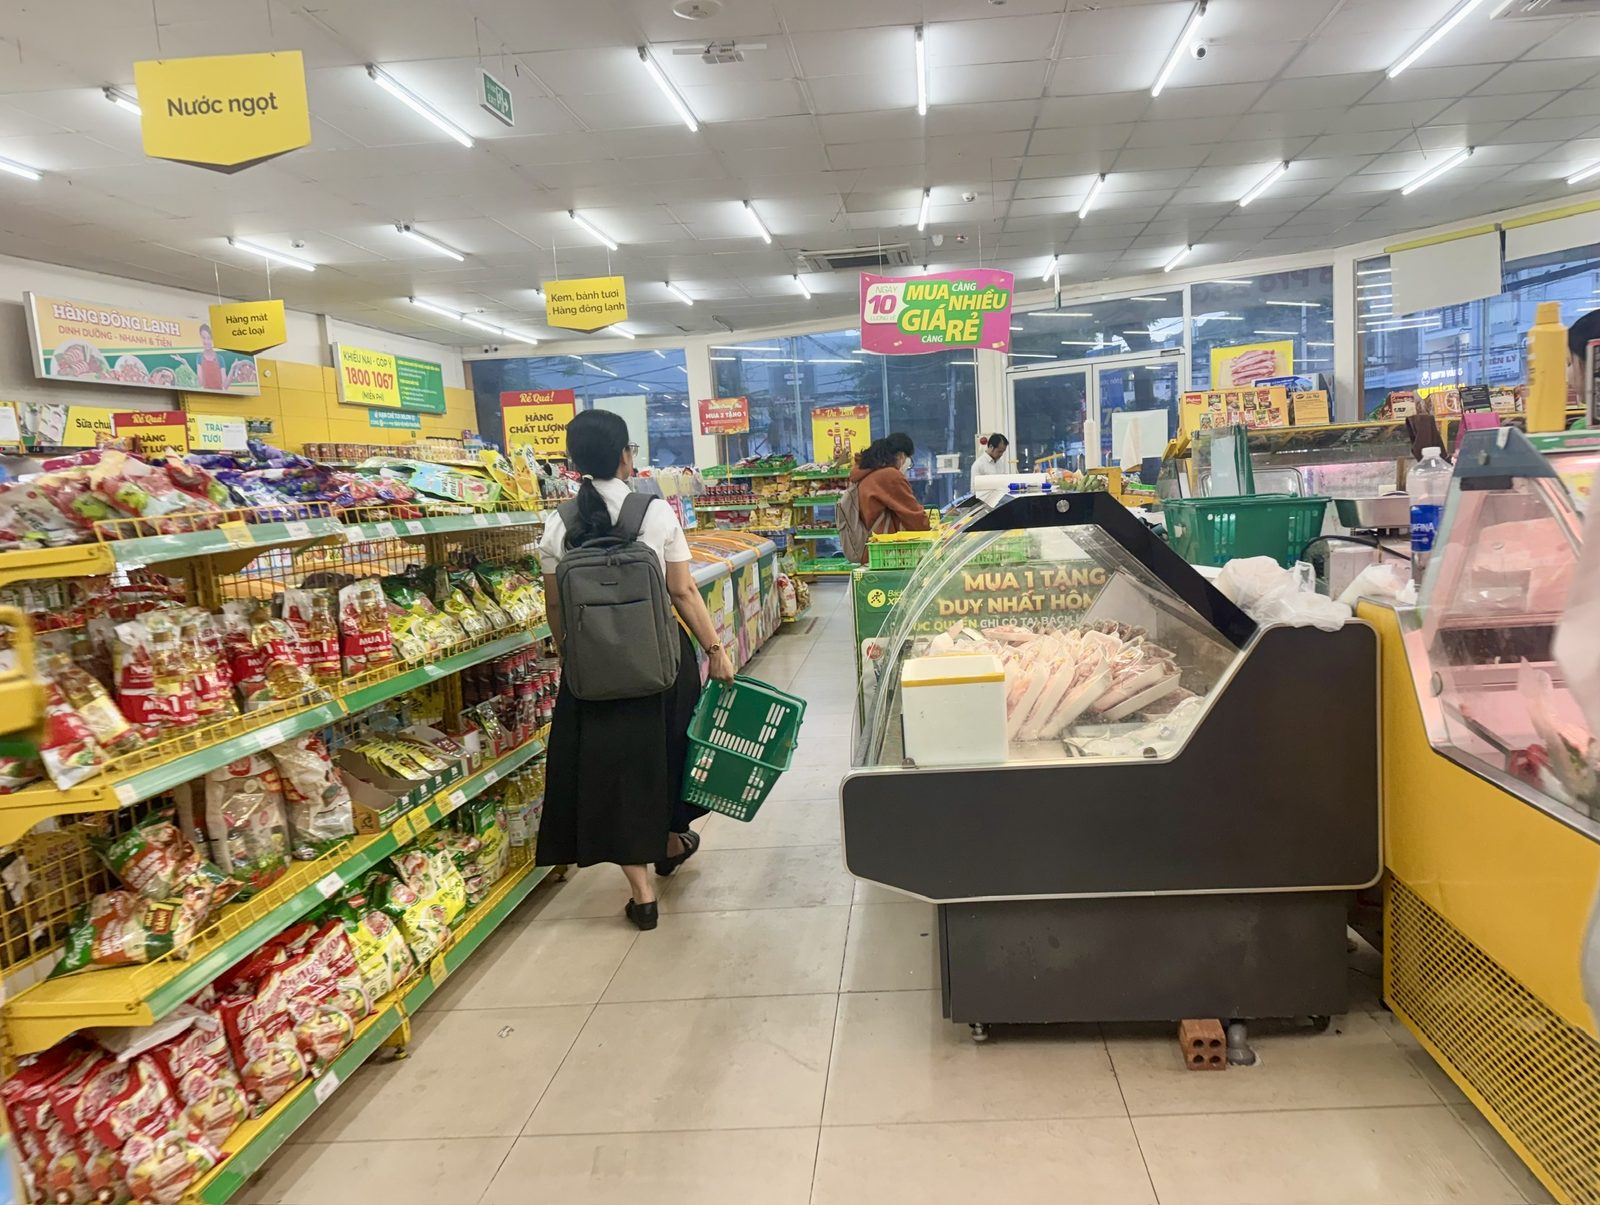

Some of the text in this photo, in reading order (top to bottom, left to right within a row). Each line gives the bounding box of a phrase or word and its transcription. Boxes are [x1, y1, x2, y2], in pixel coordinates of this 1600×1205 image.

[167, 92, 278, 117] Nước ngọt
[551, 289, 619, 302] Kem, bánh tươi
[906, 282, 976, 300] MUA CÀNG
[868, 295, 896, 314] 10
[948, 289, 1006, 310] NHIỀU
[552, 305, 577, 316] Hàng
[604, 302, 624, 312] lạnh
[226, 312, 268, 326] Hàng mát
[902, 304, 980, 342] GIÁ RẺ
[58, 326, 80, 336] DINH
[120, 334, 147, 344] NHANH
[232, 326, 264, 336] các loại
[922, 335, 943, 343] CÀNG
[346, 367, 370, 386] 1800
[372, 372, 393, 390] 1067
[520, 392, 554, 404] Rẻ Quá!
[76, 418, 92, 428] Sữa
[526, 412, 554, 422] HÀNG
[510, 423, 536, 434] CHẤT
[540, 434, 560, 444] TỐT
[964, 566, 1106, 592] MUA 1 TẶNG
[939, 598, 983, 616] DUY
[988, 590, 1044, 613] NHẤT
[1002, 616, 1018, 626] CÓ
[360, 630, 388, 646] MUA 1
[321, 640, 328, 652] 1
[168, 696, 180, 712] 1
